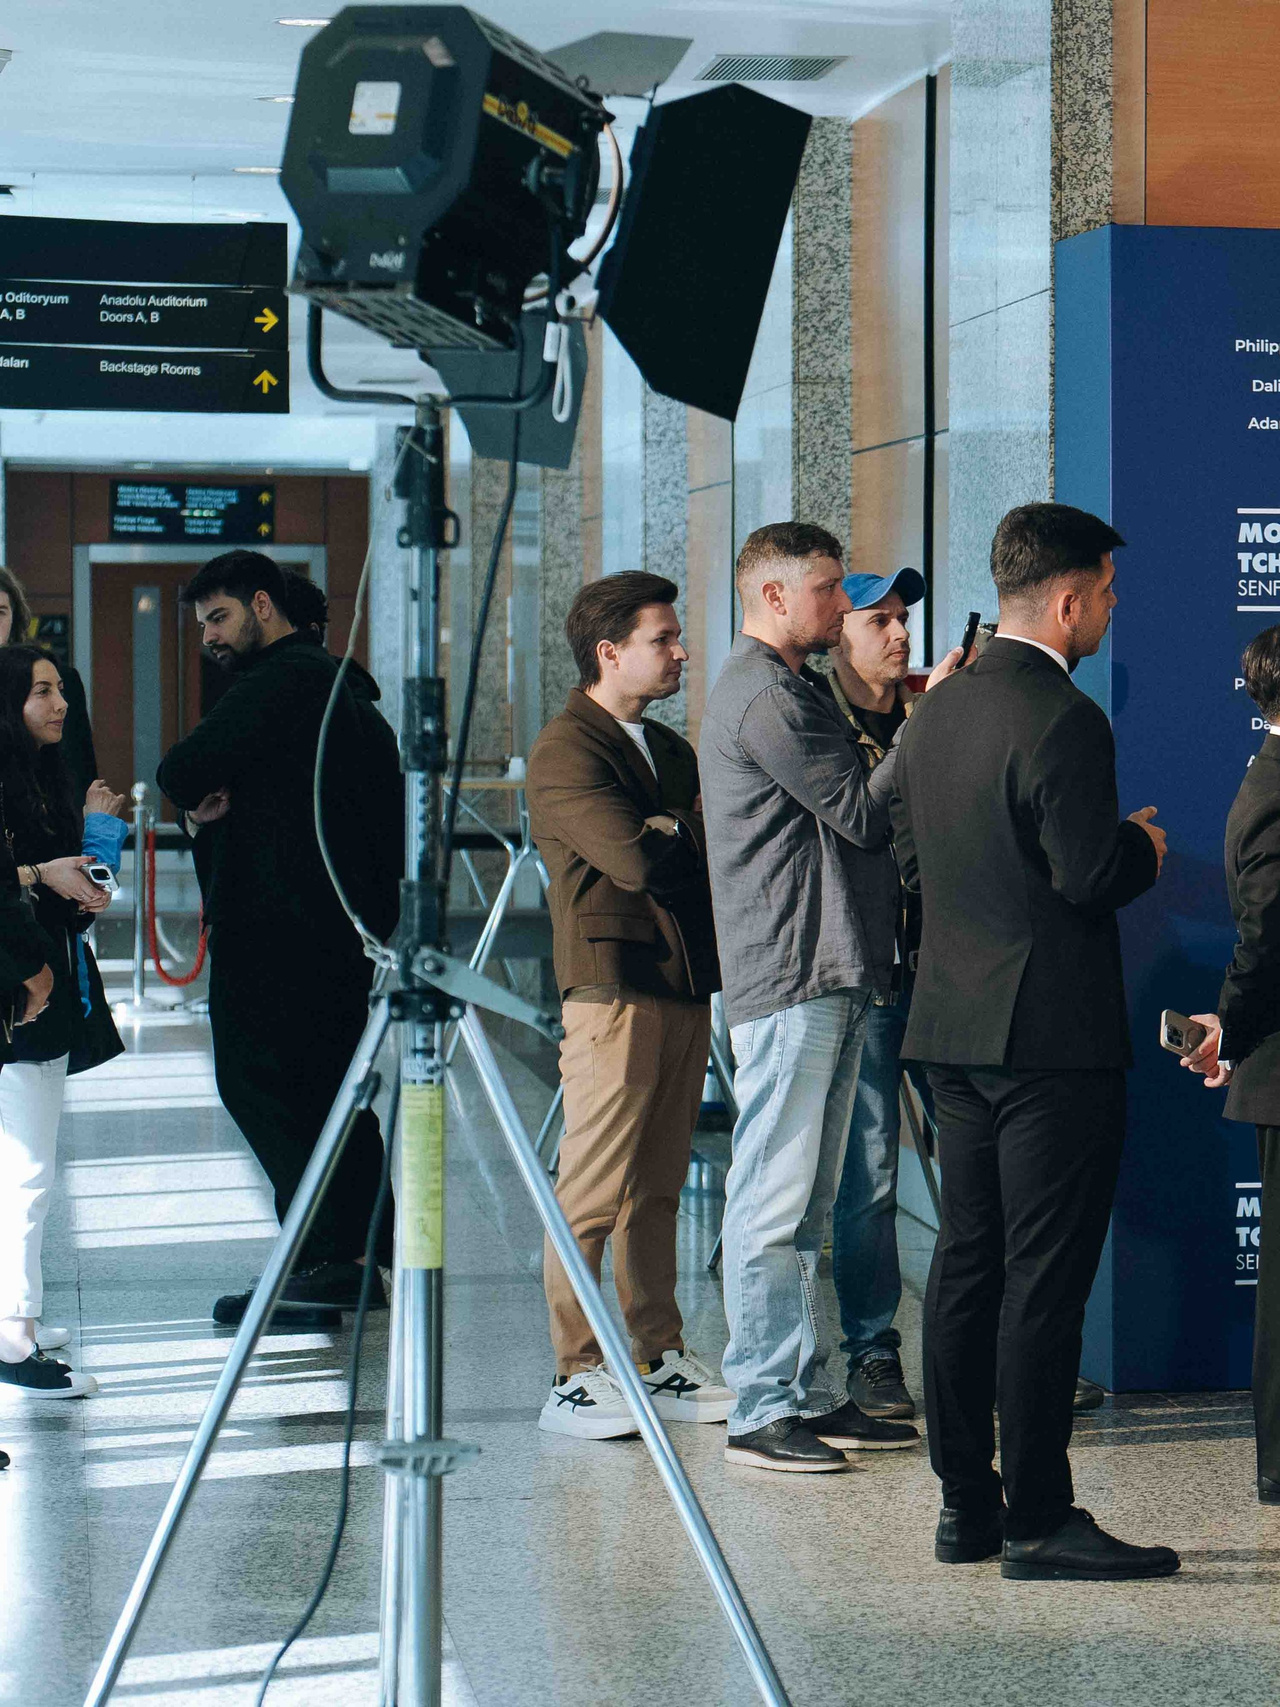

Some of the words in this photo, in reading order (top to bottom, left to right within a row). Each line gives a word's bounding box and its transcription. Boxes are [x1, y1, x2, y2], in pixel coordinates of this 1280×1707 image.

[5, 292, 69, 306] Oditoryum
[99, 294, 146, 306] Anadolu
[147, 295, 208, 307] Auditorium
[16, 309, 26, 320] B
[100, 310, 134, 322] Doors
[135, 311, 147, 324] A,
[150, 312, 160, 323] B
[100, 360, 158, 376] Backstage
[161, 363, 201, 376] Rooms
[1251, 717, 1271, 730] Da
